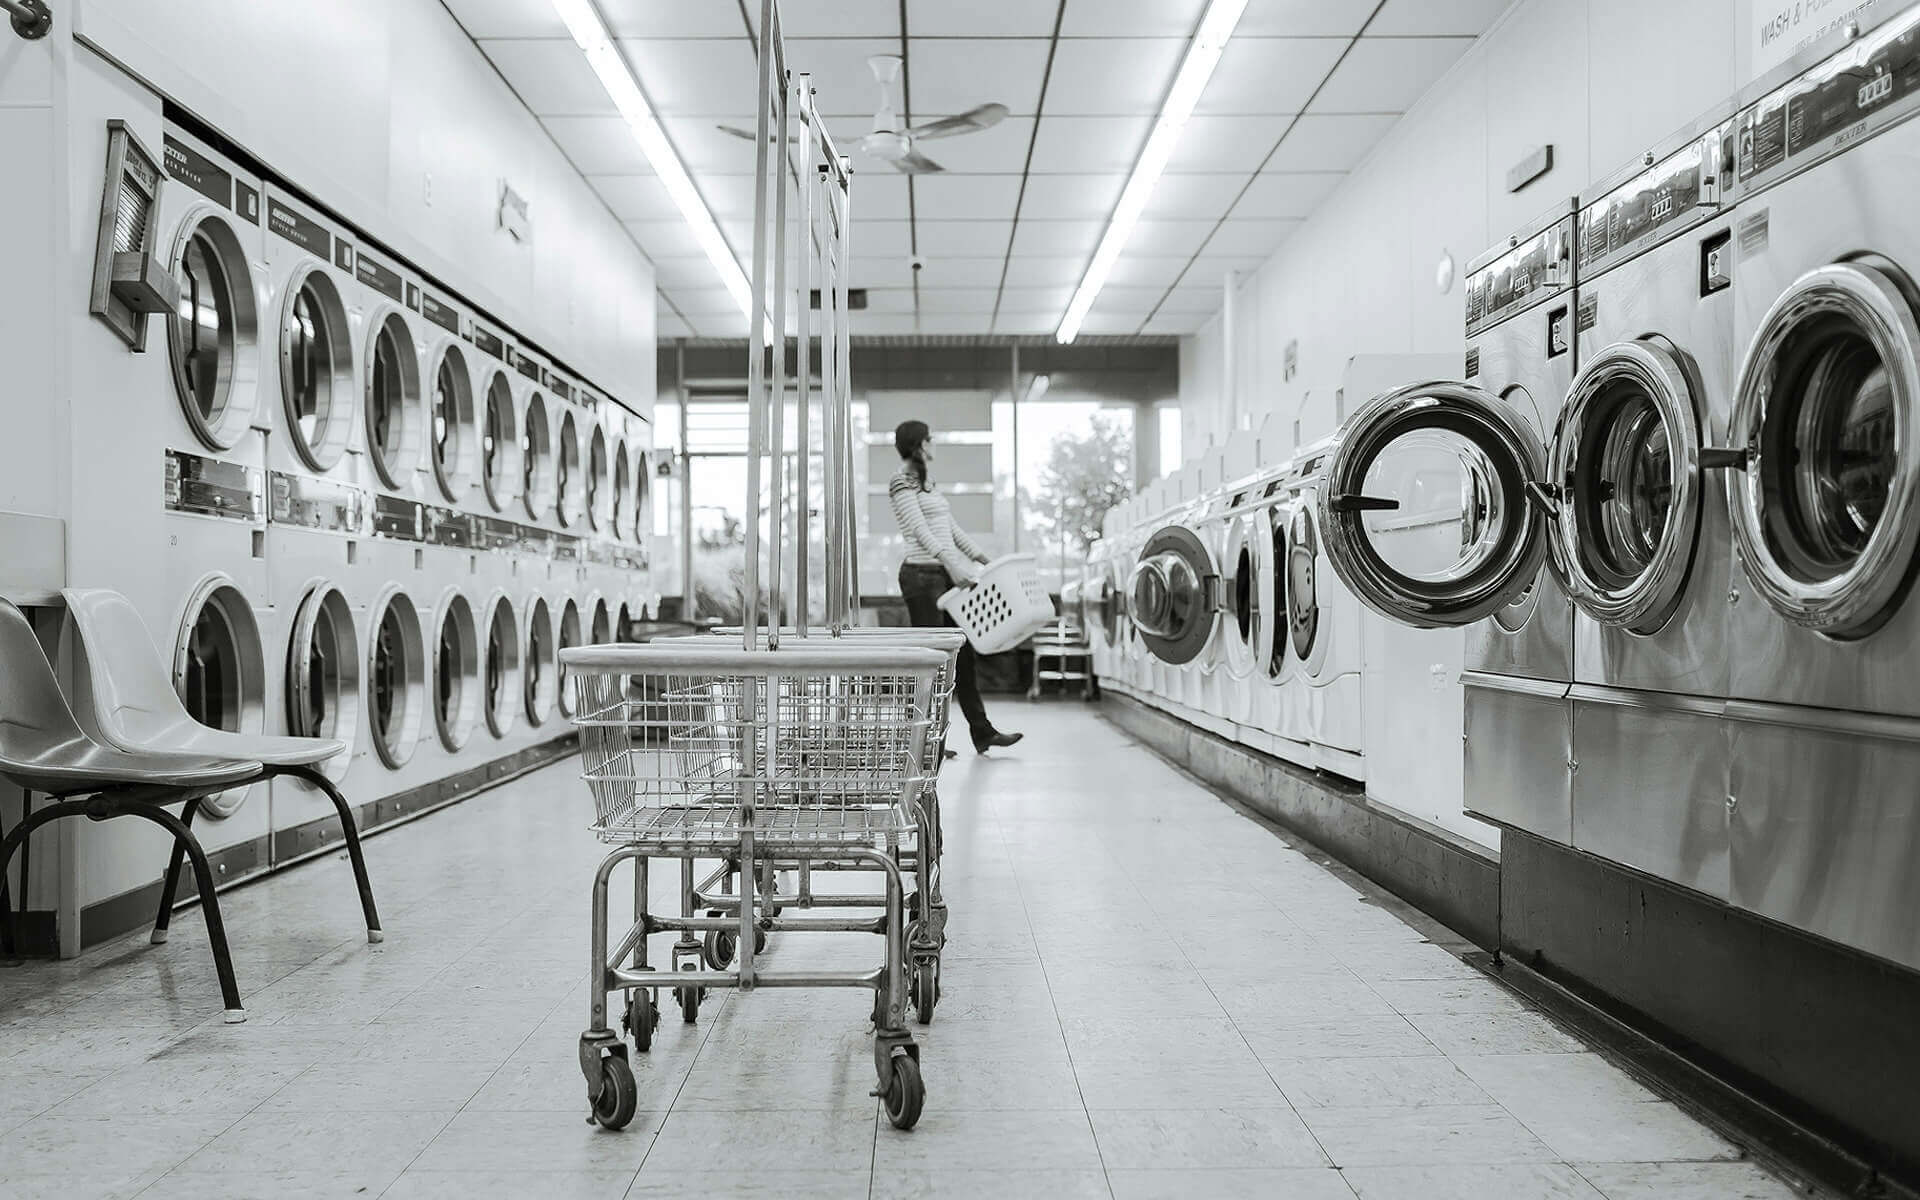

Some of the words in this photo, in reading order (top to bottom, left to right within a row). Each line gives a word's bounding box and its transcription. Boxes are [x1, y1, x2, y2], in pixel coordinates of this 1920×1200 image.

[1761, 8, 1791, 48] WASH
[1793, 1, 1801, 25] &
[1833, 122, 1868, 146] DEXTER
